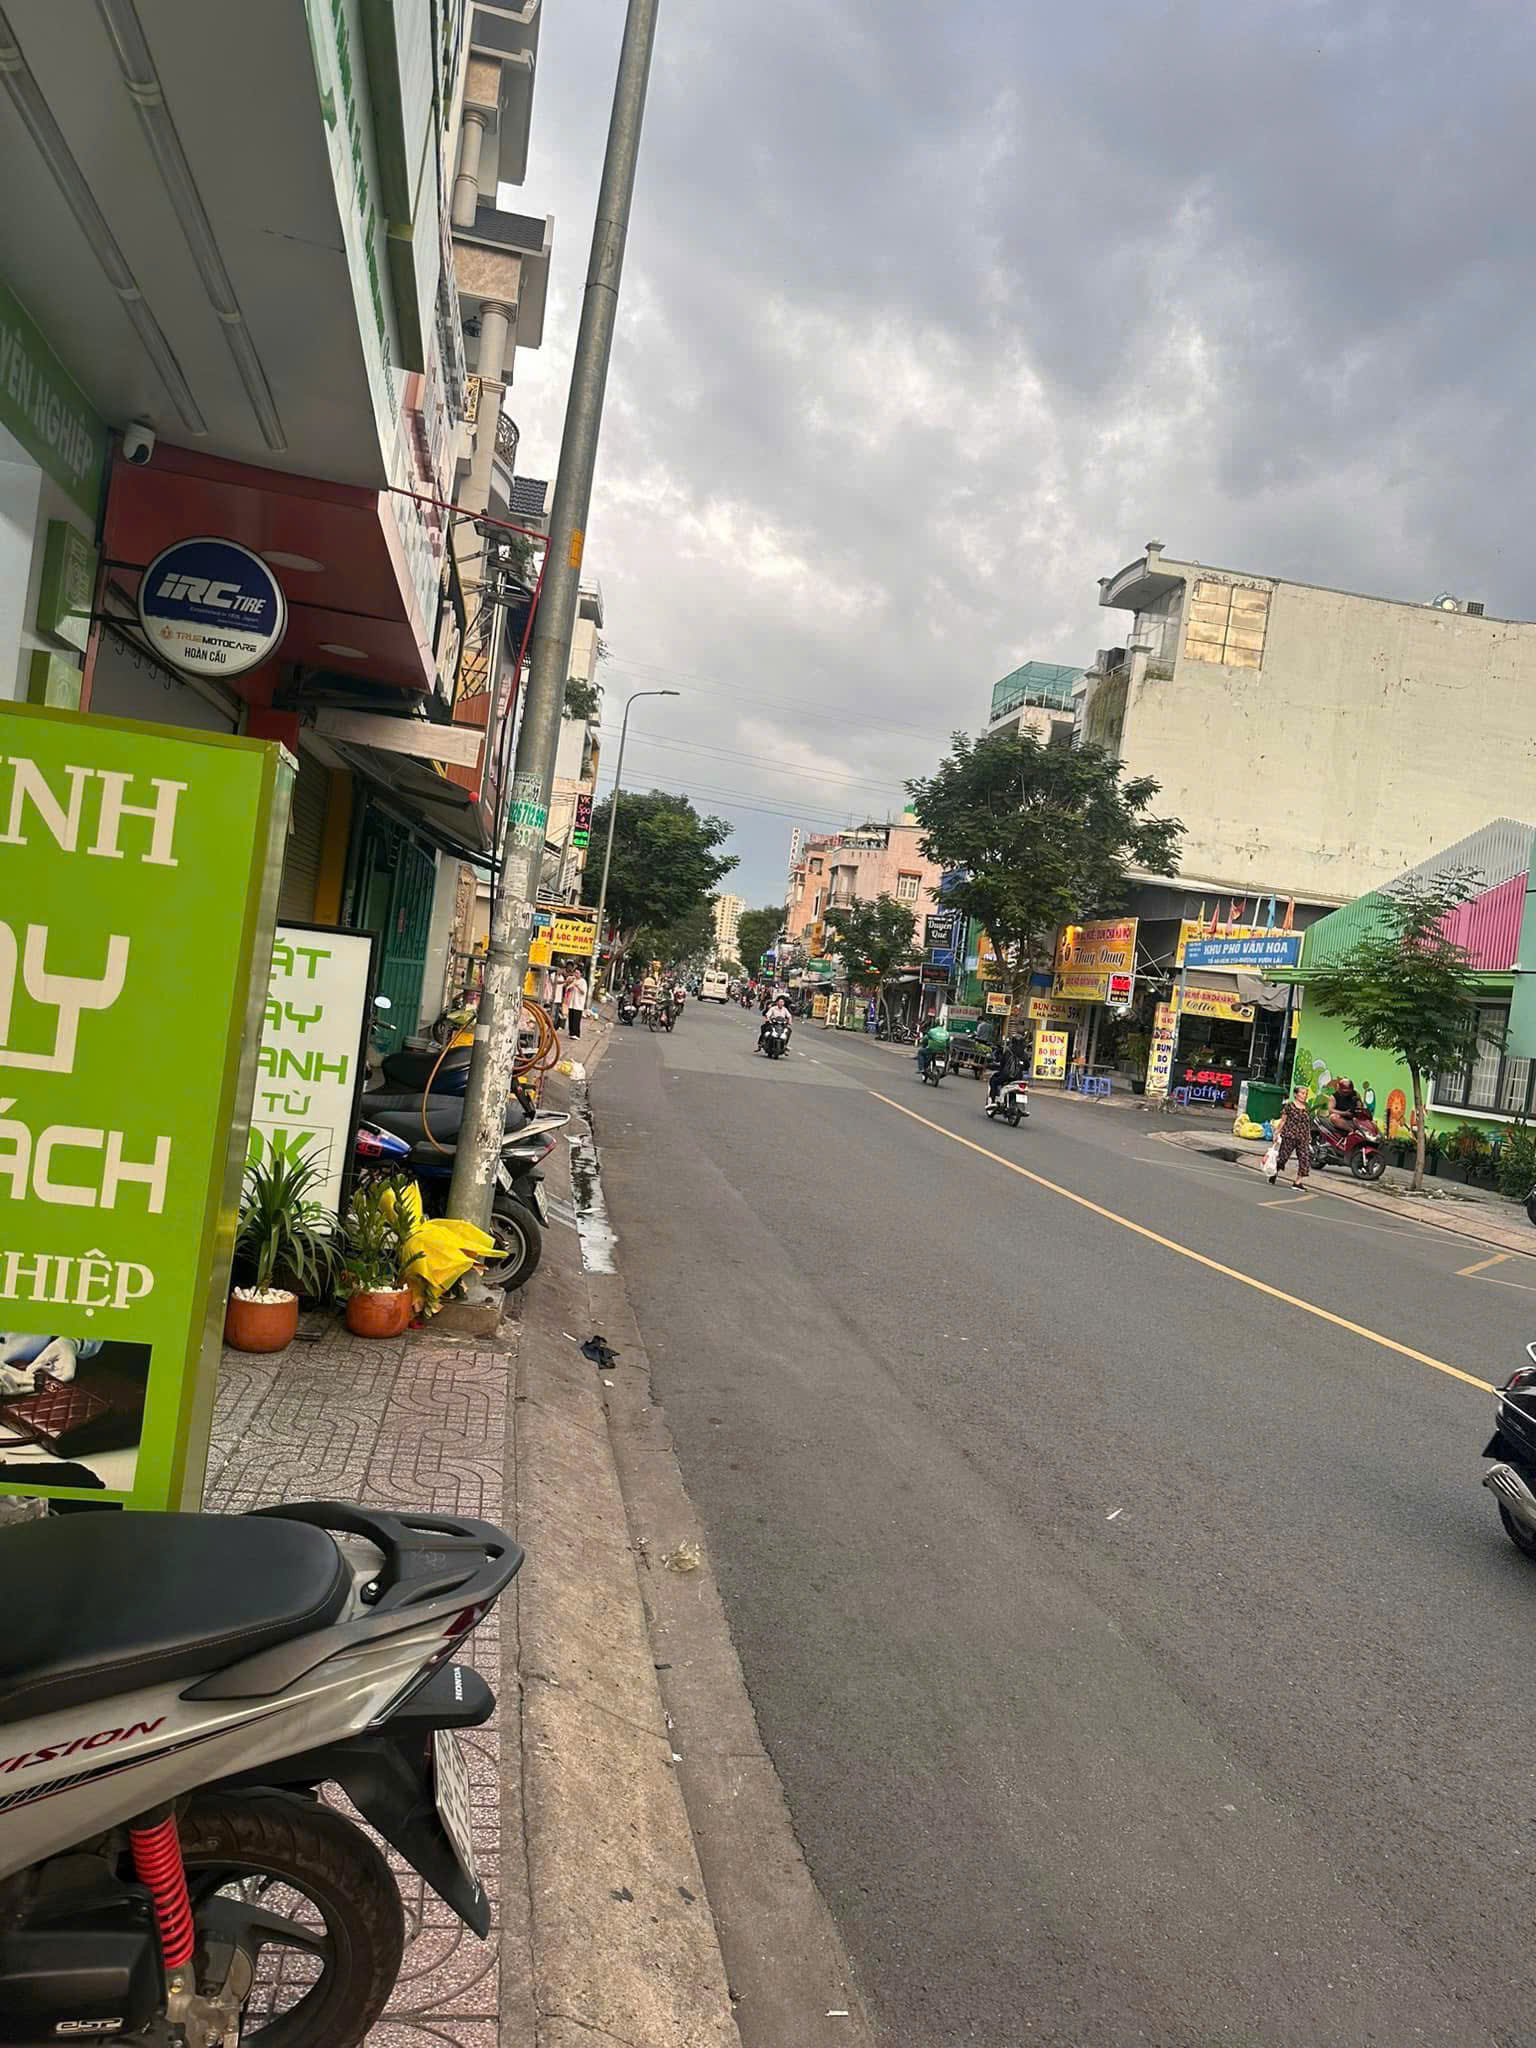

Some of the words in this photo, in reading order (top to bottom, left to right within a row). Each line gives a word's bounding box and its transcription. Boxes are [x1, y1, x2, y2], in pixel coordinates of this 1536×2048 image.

[232, 595, 267, 614] TIRE
[1204, 945, 1221, 955] KHU
[454, 1666, 463, 1701] HONDA
